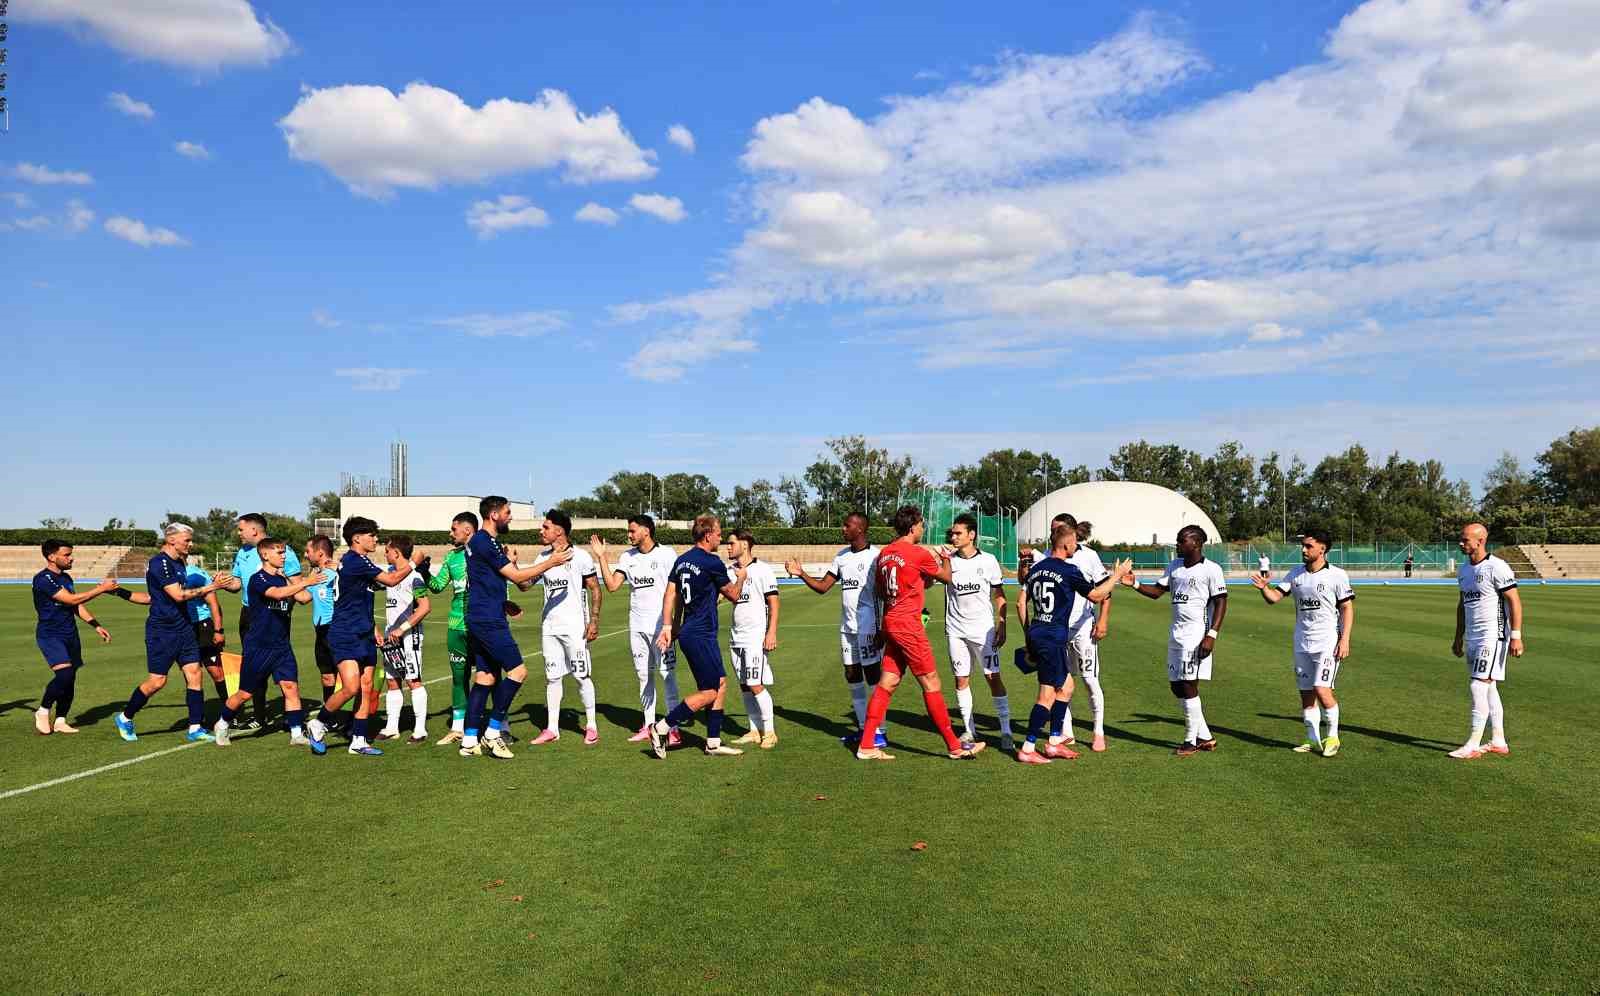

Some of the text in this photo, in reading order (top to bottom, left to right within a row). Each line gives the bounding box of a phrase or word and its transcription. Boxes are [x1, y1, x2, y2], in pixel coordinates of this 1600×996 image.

[634, 577, 654, 585] beko
[957, 582, 981, 591] beko
[1032, 581, 1055, 613] 95
[570, 660, 586, 673] 53
[984, 655, 999, 669] 70
[1078, 658, 1092, 672] 22
[1183, 661, 1194, 674] 15
[1473, 658, 1487, 673] 18
[1321, 668, 1329, 681] 8
